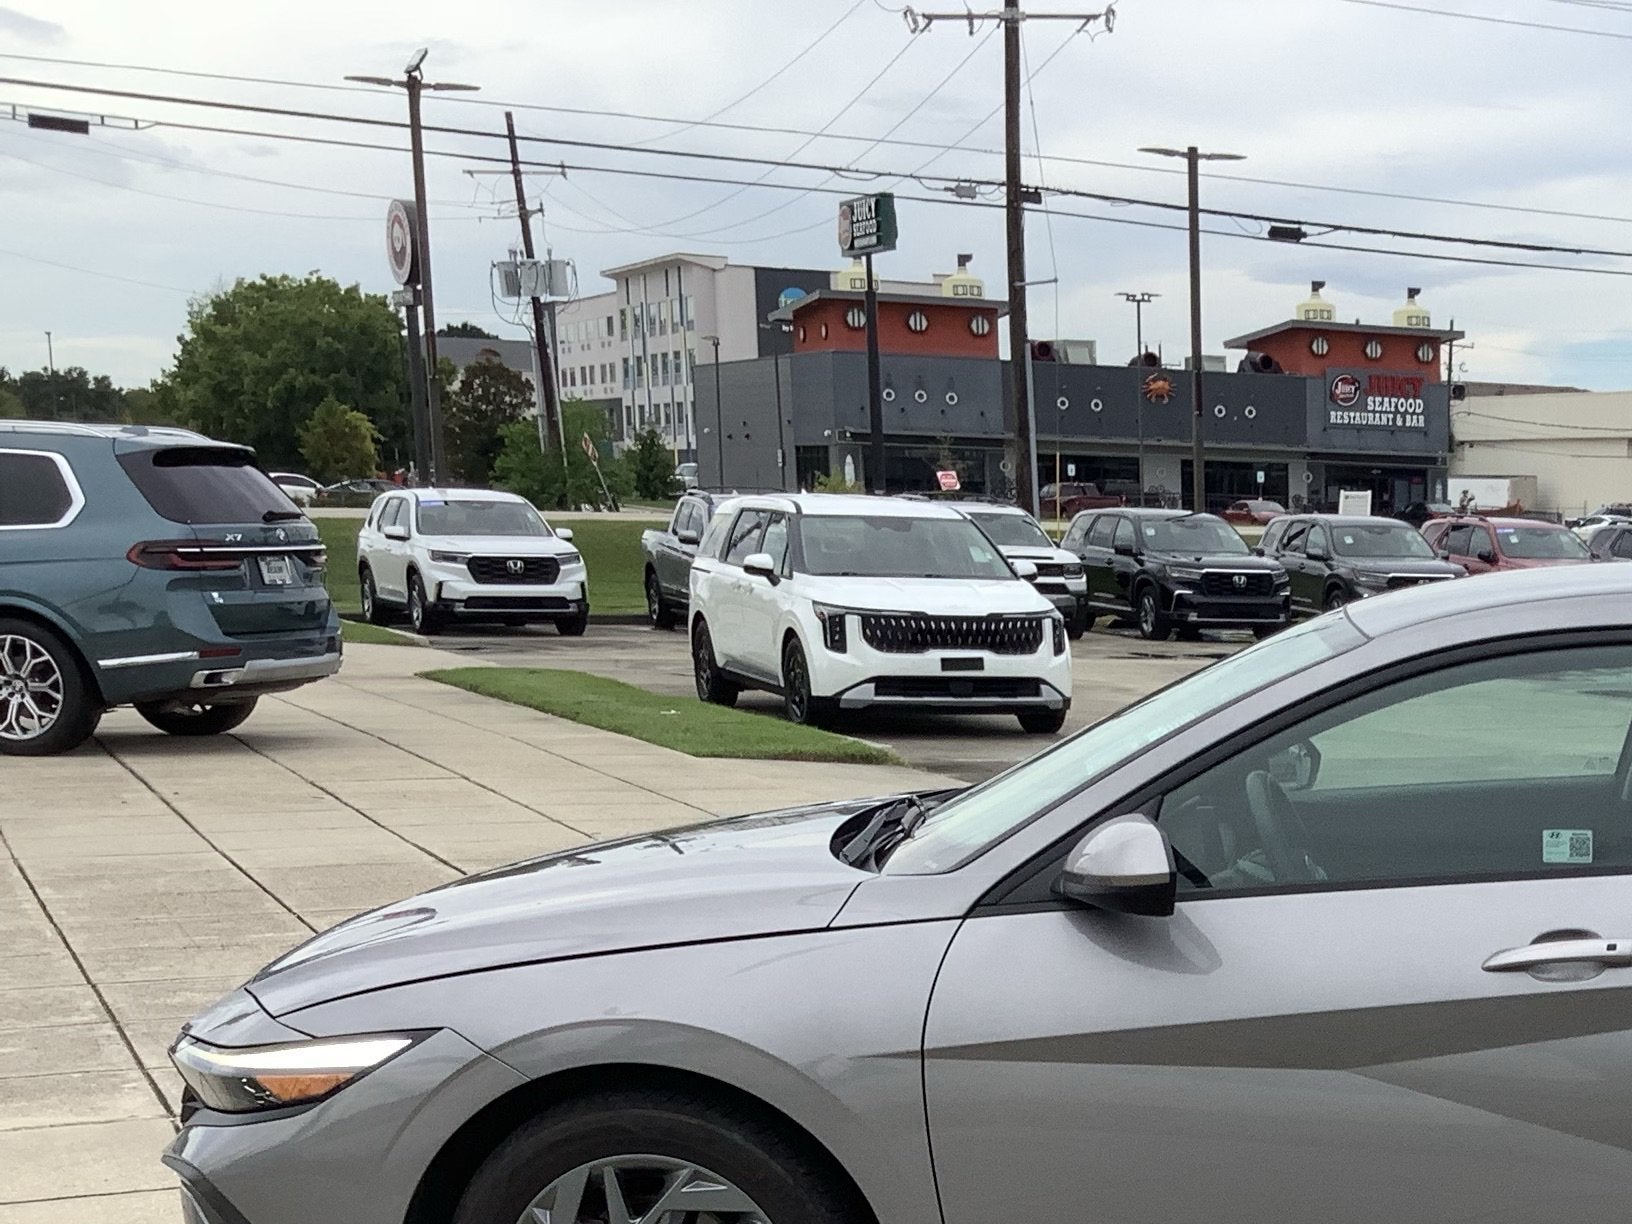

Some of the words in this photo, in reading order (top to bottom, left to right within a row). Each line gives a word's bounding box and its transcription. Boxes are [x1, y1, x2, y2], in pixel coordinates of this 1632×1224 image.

[853, 198, 876, 222] JUICY
[1364, 375, 1424, 397] JUICY
[1367, 396, 1424, 413] SEAFOOD
[1330, 411, 1394, 426] RESTAURANT
[1396, 414, 1403, 426] &
[1405, 415, 1425, 427] BAR
[225, 533, 242, 541] X7
